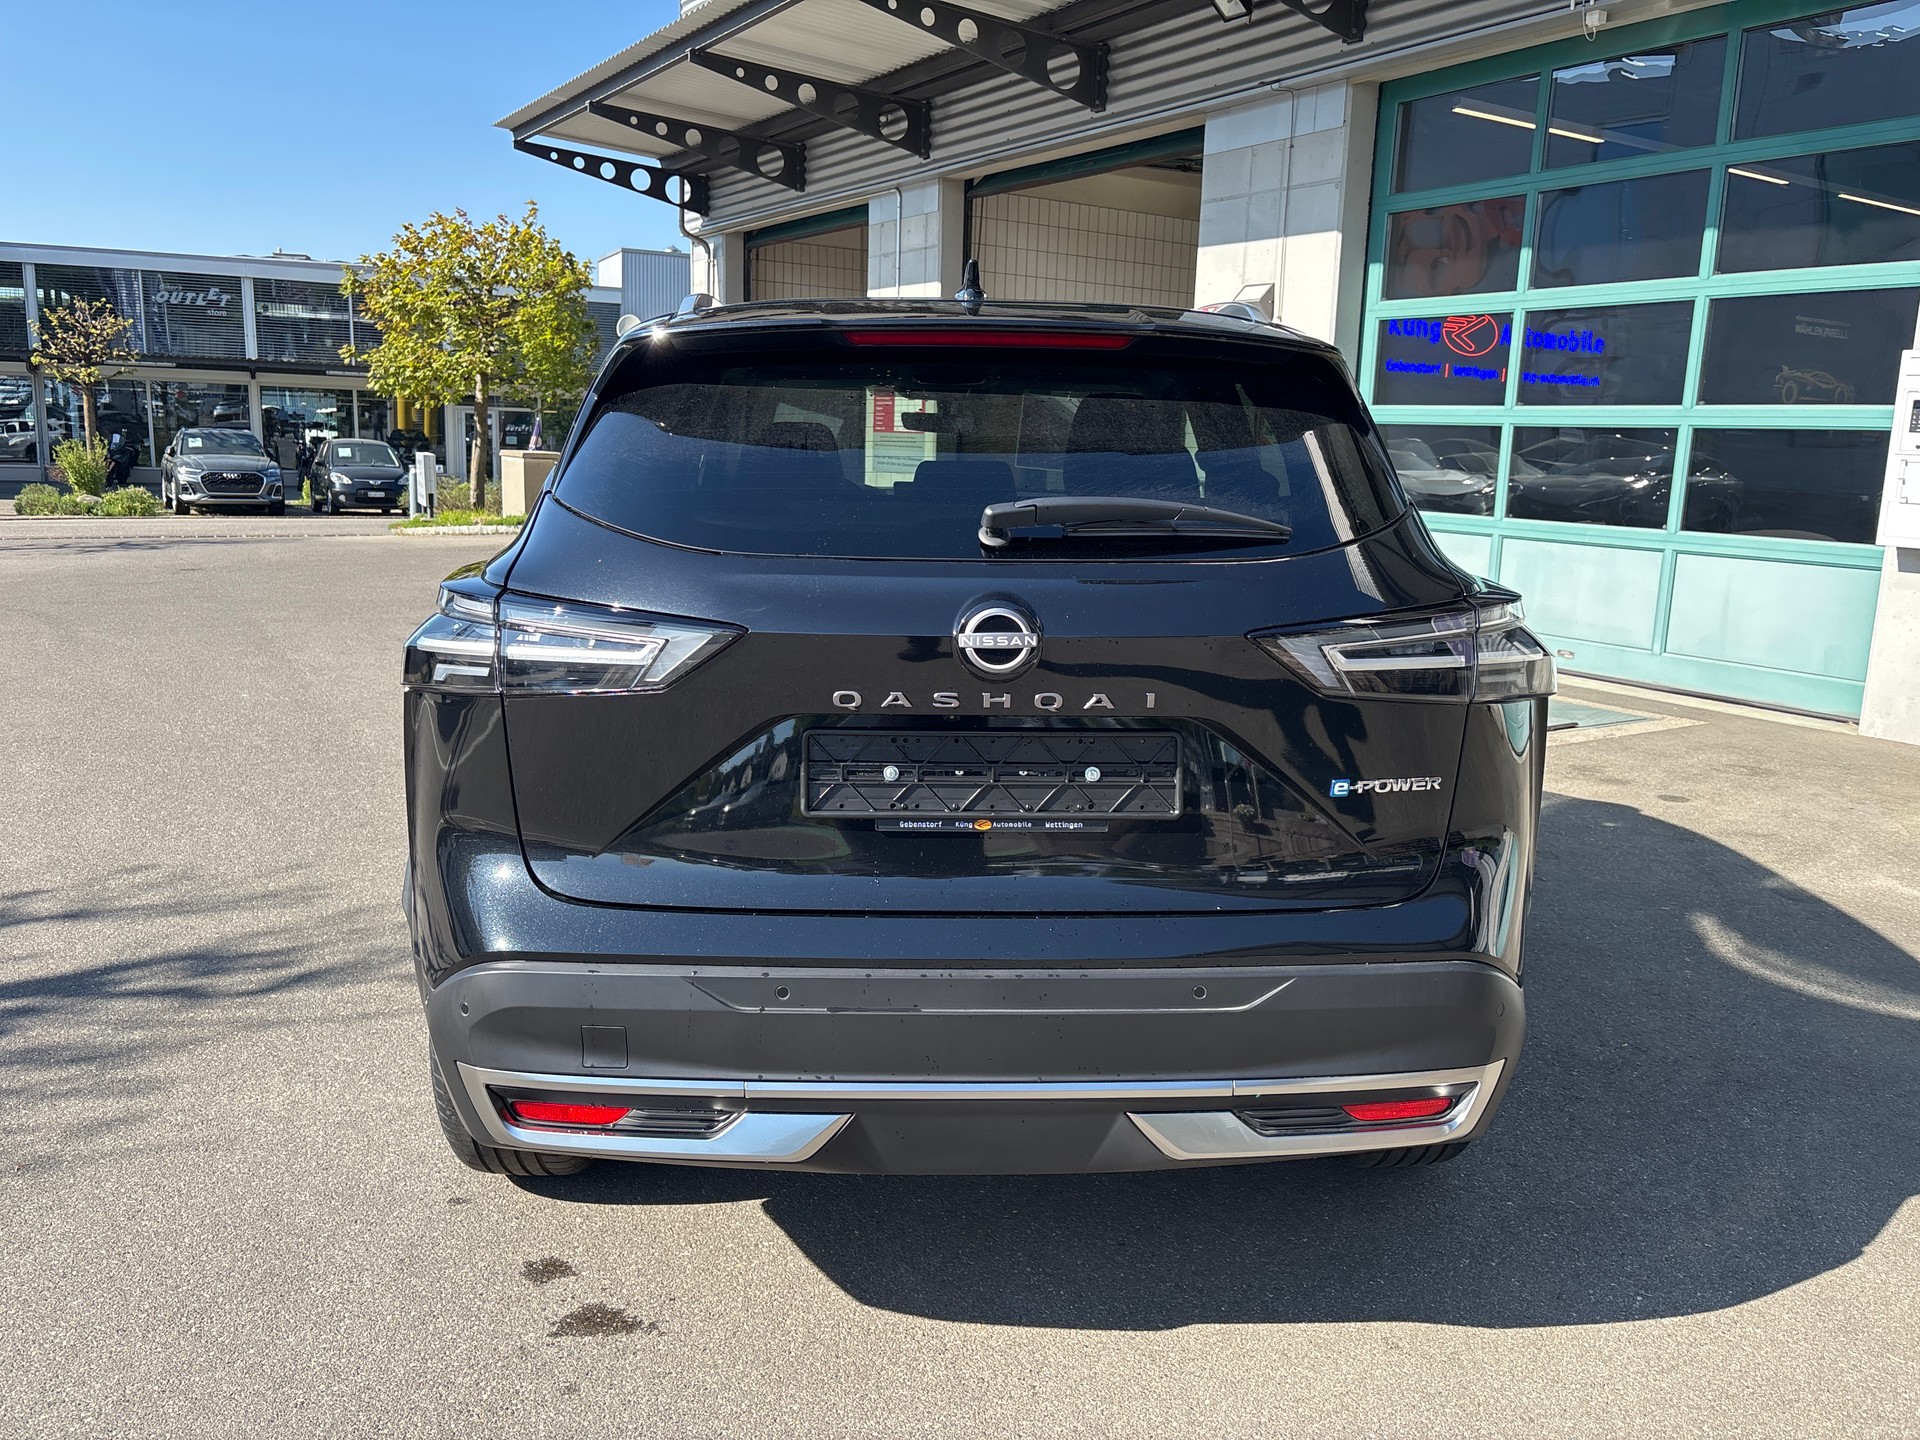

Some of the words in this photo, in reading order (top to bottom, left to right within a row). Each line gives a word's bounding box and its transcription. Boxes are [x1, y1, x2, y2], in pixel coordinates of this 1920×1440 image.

[155, 287, 231, 307] OUTLET
[1500, 323, 1605, 354] Atomobile
[961, 636, 1037, 646] NISSAN
[832, 690, 1156, 712] QASHQAI
[1331, 776, 1442, 796] e-POWER
[899, 820, 943, 828] Gebenstorf
[955, 821, 973, 829] Küng
[1045, 820, 1083, 829] Wettingen
